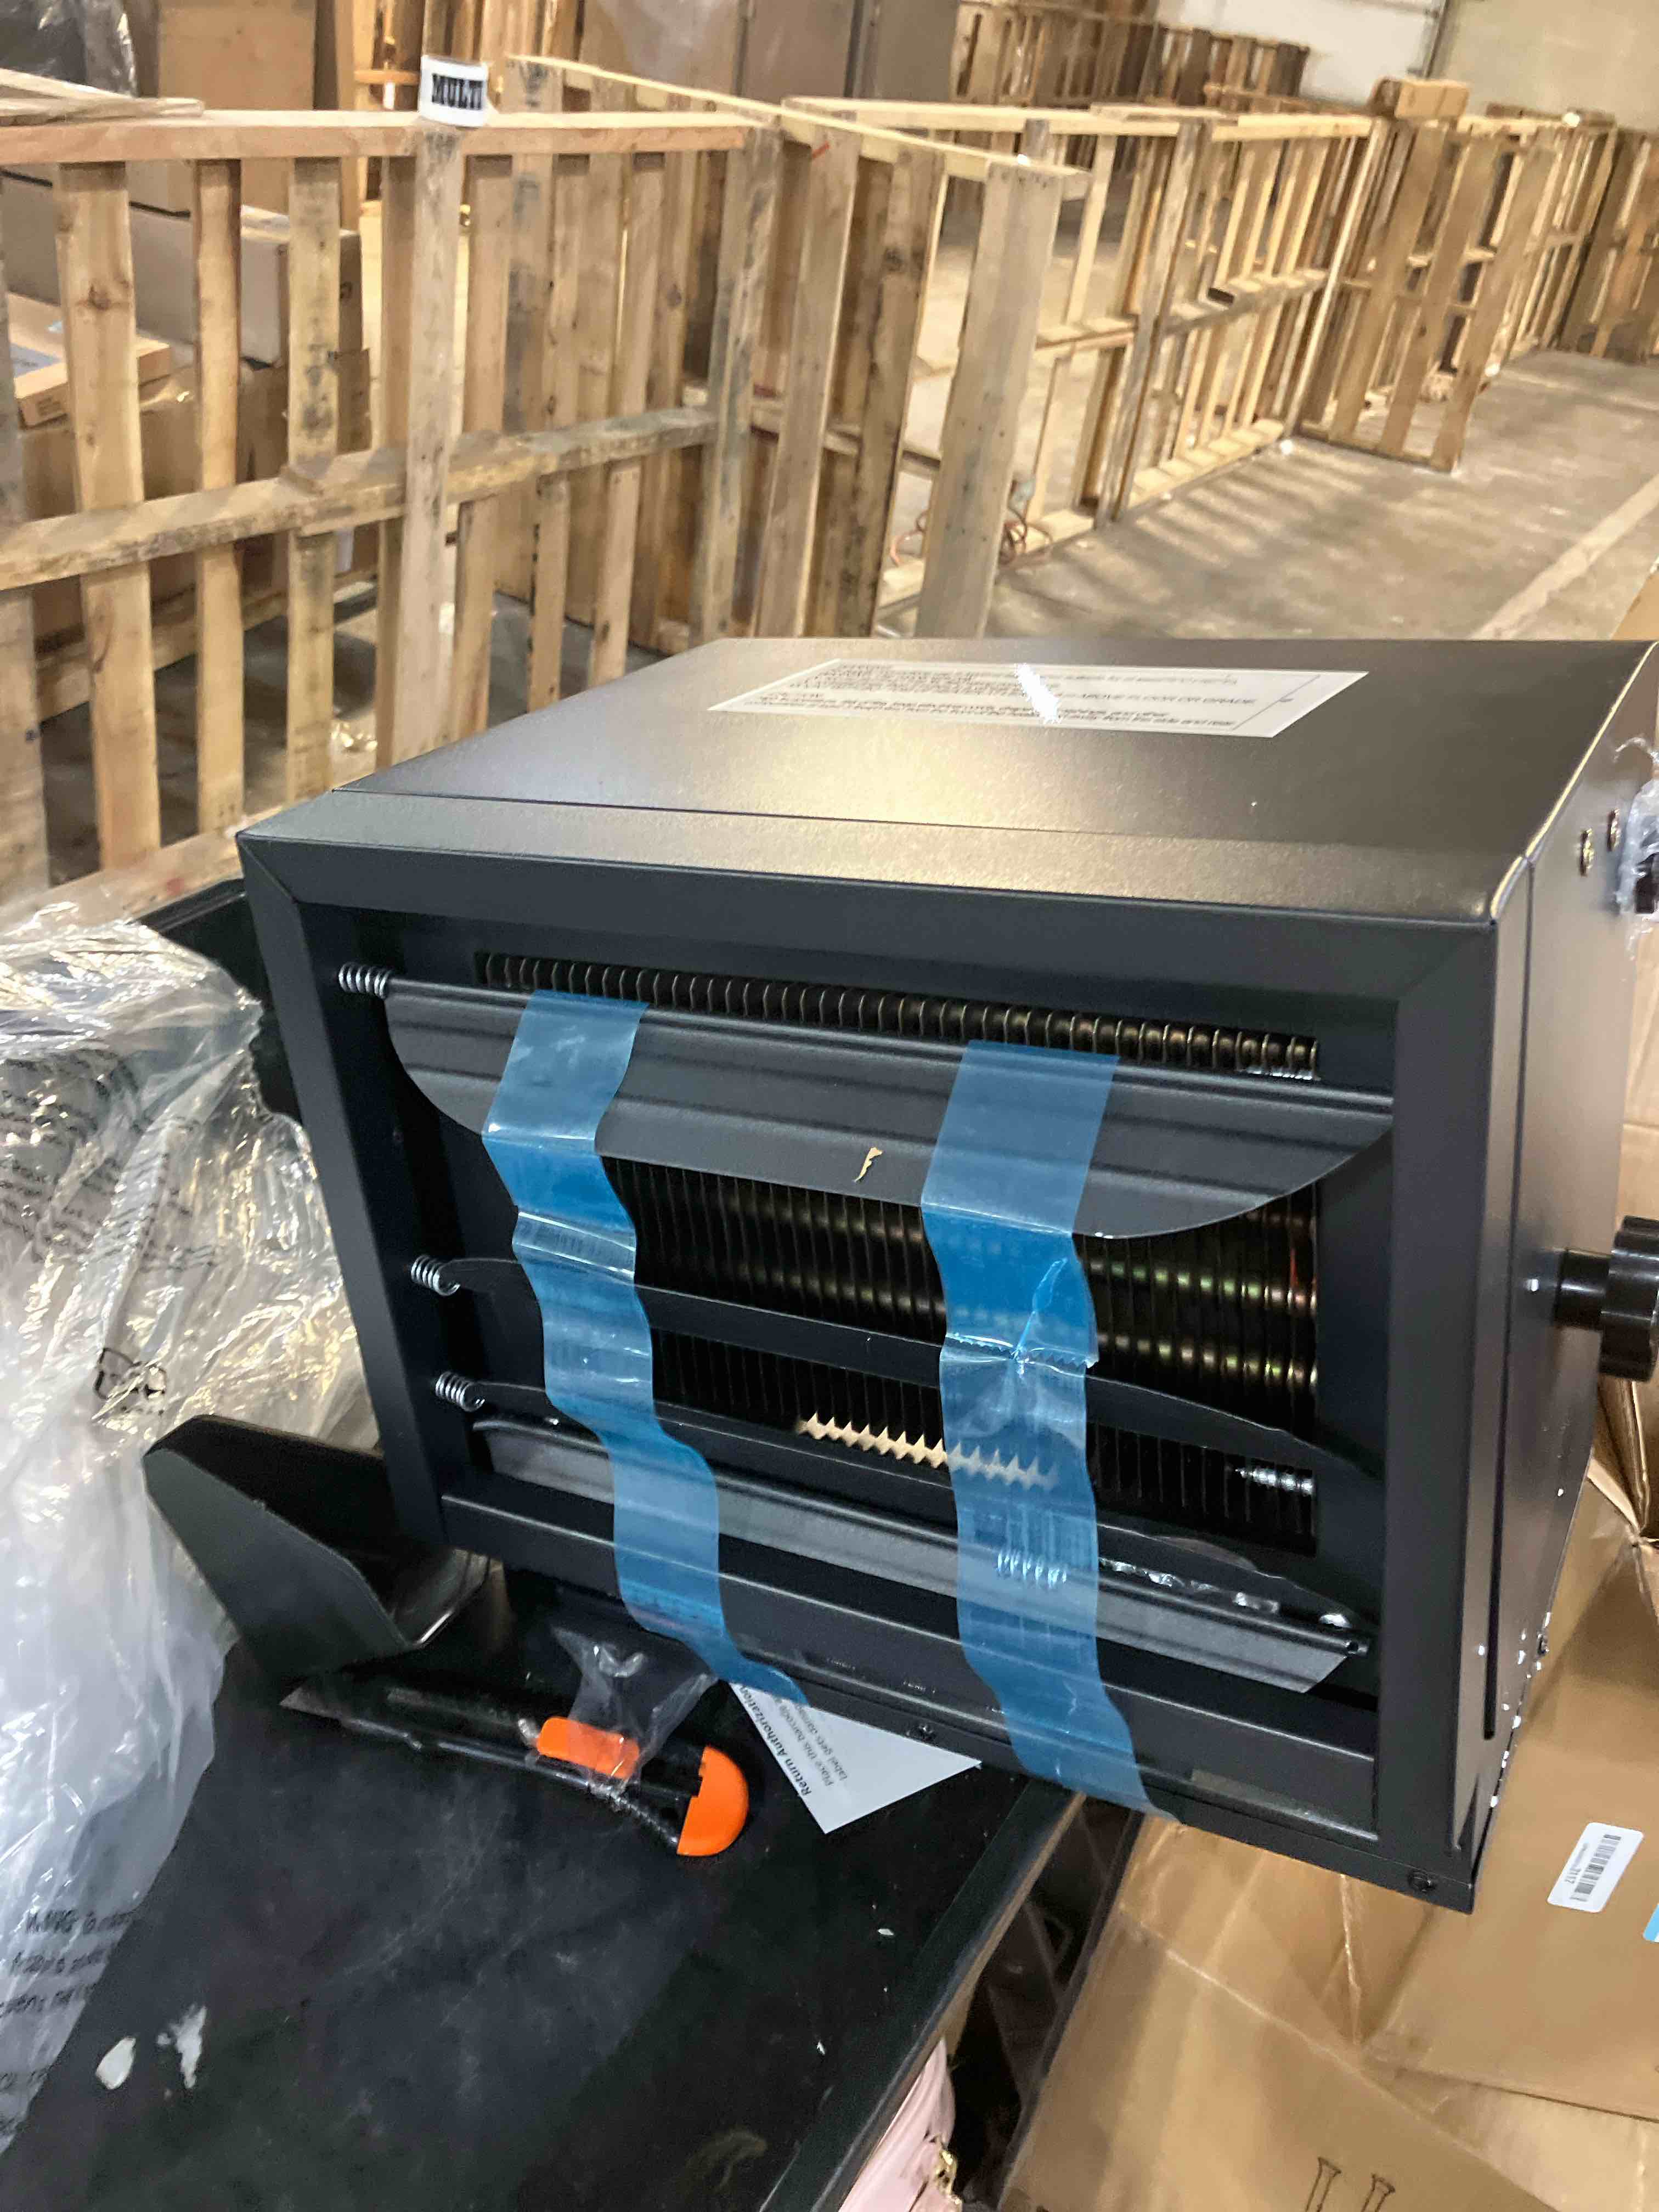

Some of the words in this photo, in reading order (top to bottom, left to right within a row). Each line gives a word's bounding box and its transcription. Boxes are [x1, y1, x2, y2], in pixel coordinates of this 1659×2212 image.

[740, 1685, 788, 1757] Authorization
[803, 1742, 817, 1760] this
[817, 1735, 833, 1756] gets
[785, 1758, 811, 1796] Return
[816, 1761, 834, 1786] Place
[830, 1758, 848, 1781] label
